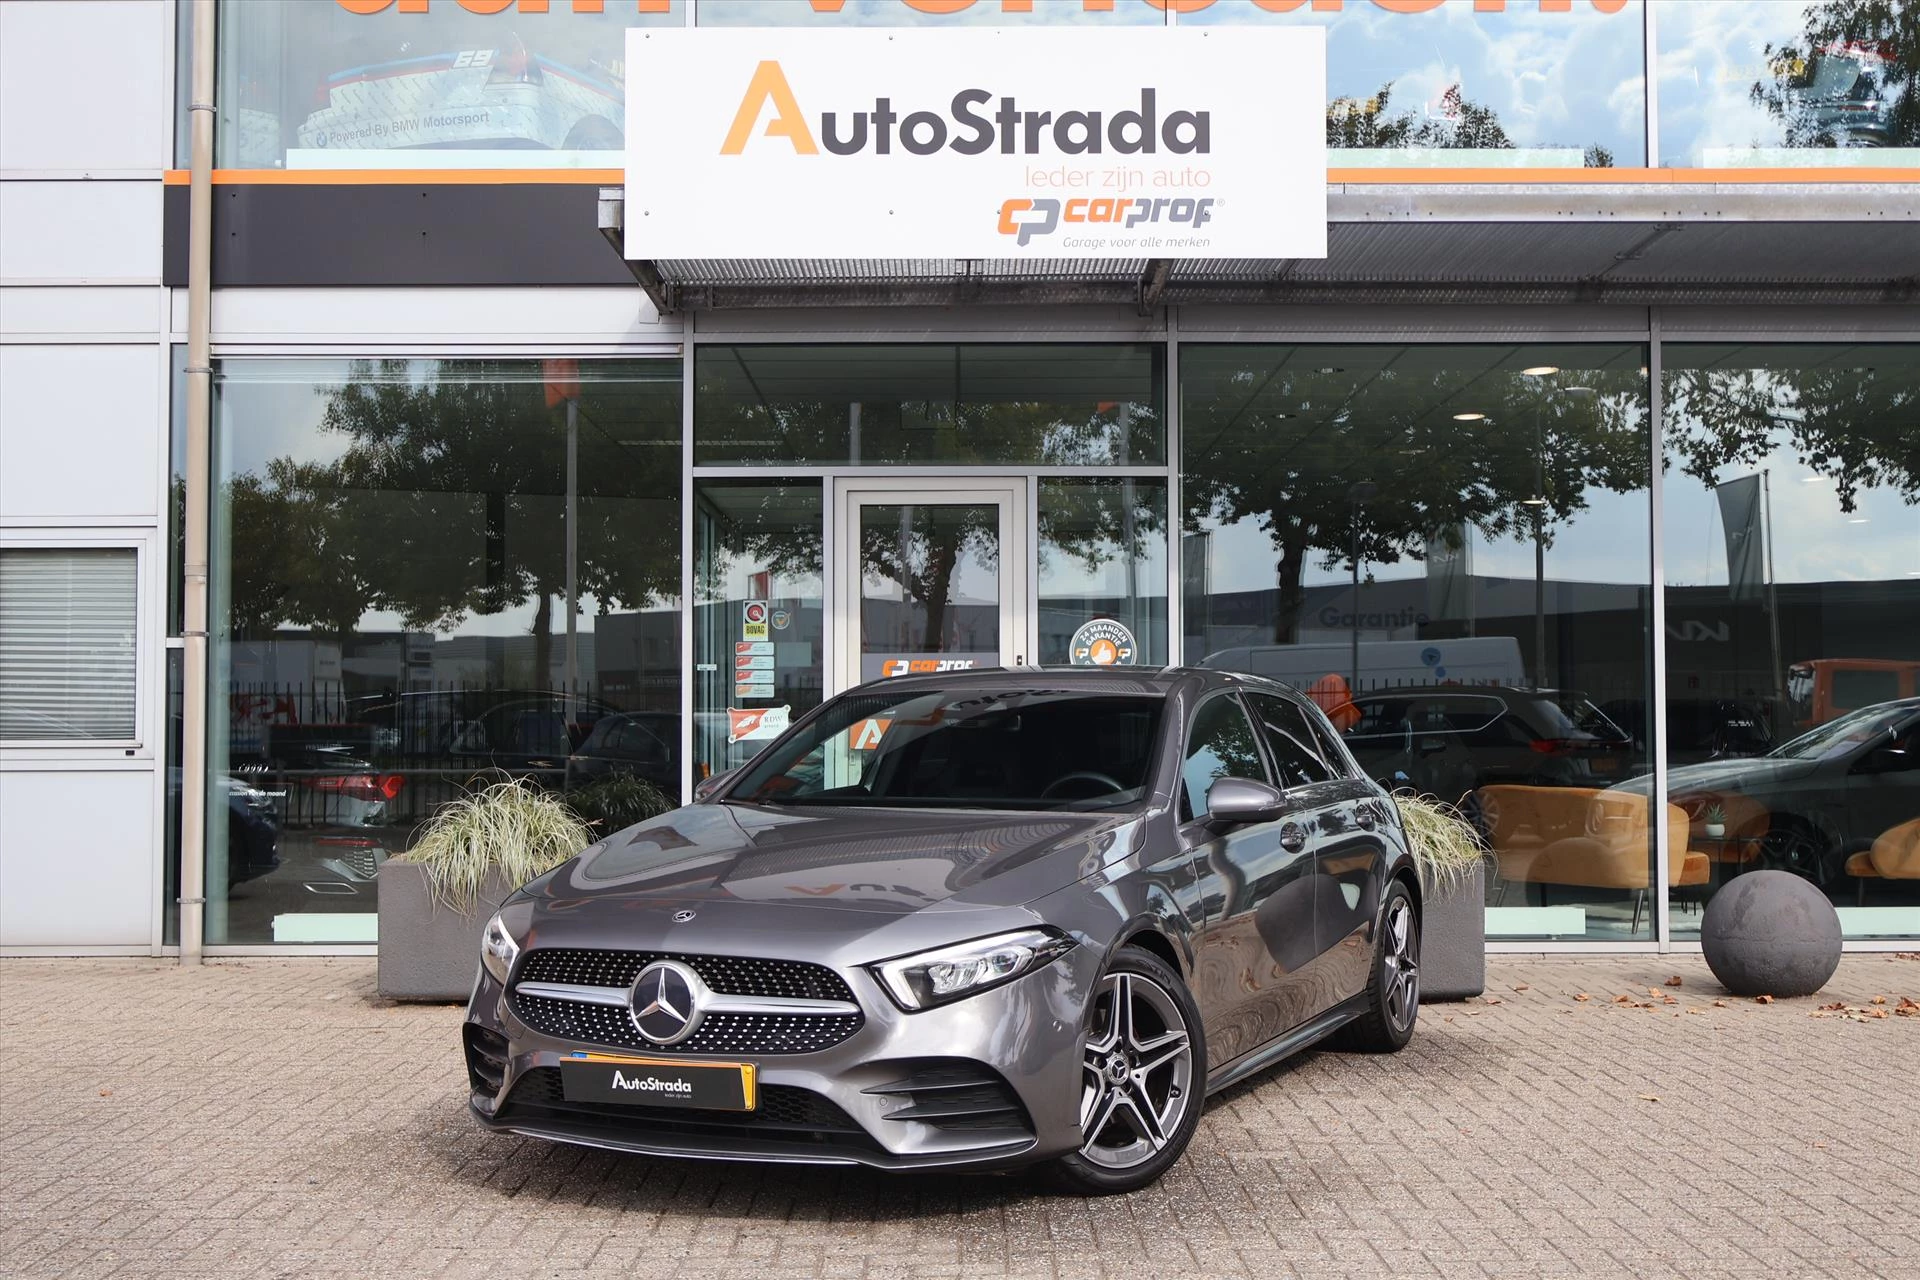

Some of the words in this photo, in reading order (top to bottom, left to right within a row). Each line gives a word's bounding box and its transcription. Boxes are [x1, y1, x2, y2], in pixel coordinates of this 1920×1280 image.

[453, 49, 494, 68] 69
[719, 60, 1211, 155] AutoStrada
[329, 124, 372, 143] Powered
[375, 123, 389, 137] By
[392, 119, 420, 133] BMW
[423, 111, 490, 129] Motorsport
[1025, 165, 1094, 188] Ieder
[1102, 165, 1144, 193] zijn
[1152, 167, 1211, 188] auto
[1063, 198, 1215, 228] carprof
[1063, 236, 1106, 250] Garage
[1110, 239, 1137, 248] voor
[1140, 236, 1162, 248] alle
[1165, 236, 1210, 248] merken
[1318, 606, 1430, 628] Garantie
[745, 624, 765, 635] BOVAG
[1080, 631, 1089, 642] 24
[1090, 624, 1128, 643] MAANDEN
[1085, 631, 1122, 647] GARANTIE
[764, 715, 783, 723] RDW
[611, 1070, 692, 1093] AutoStrada
